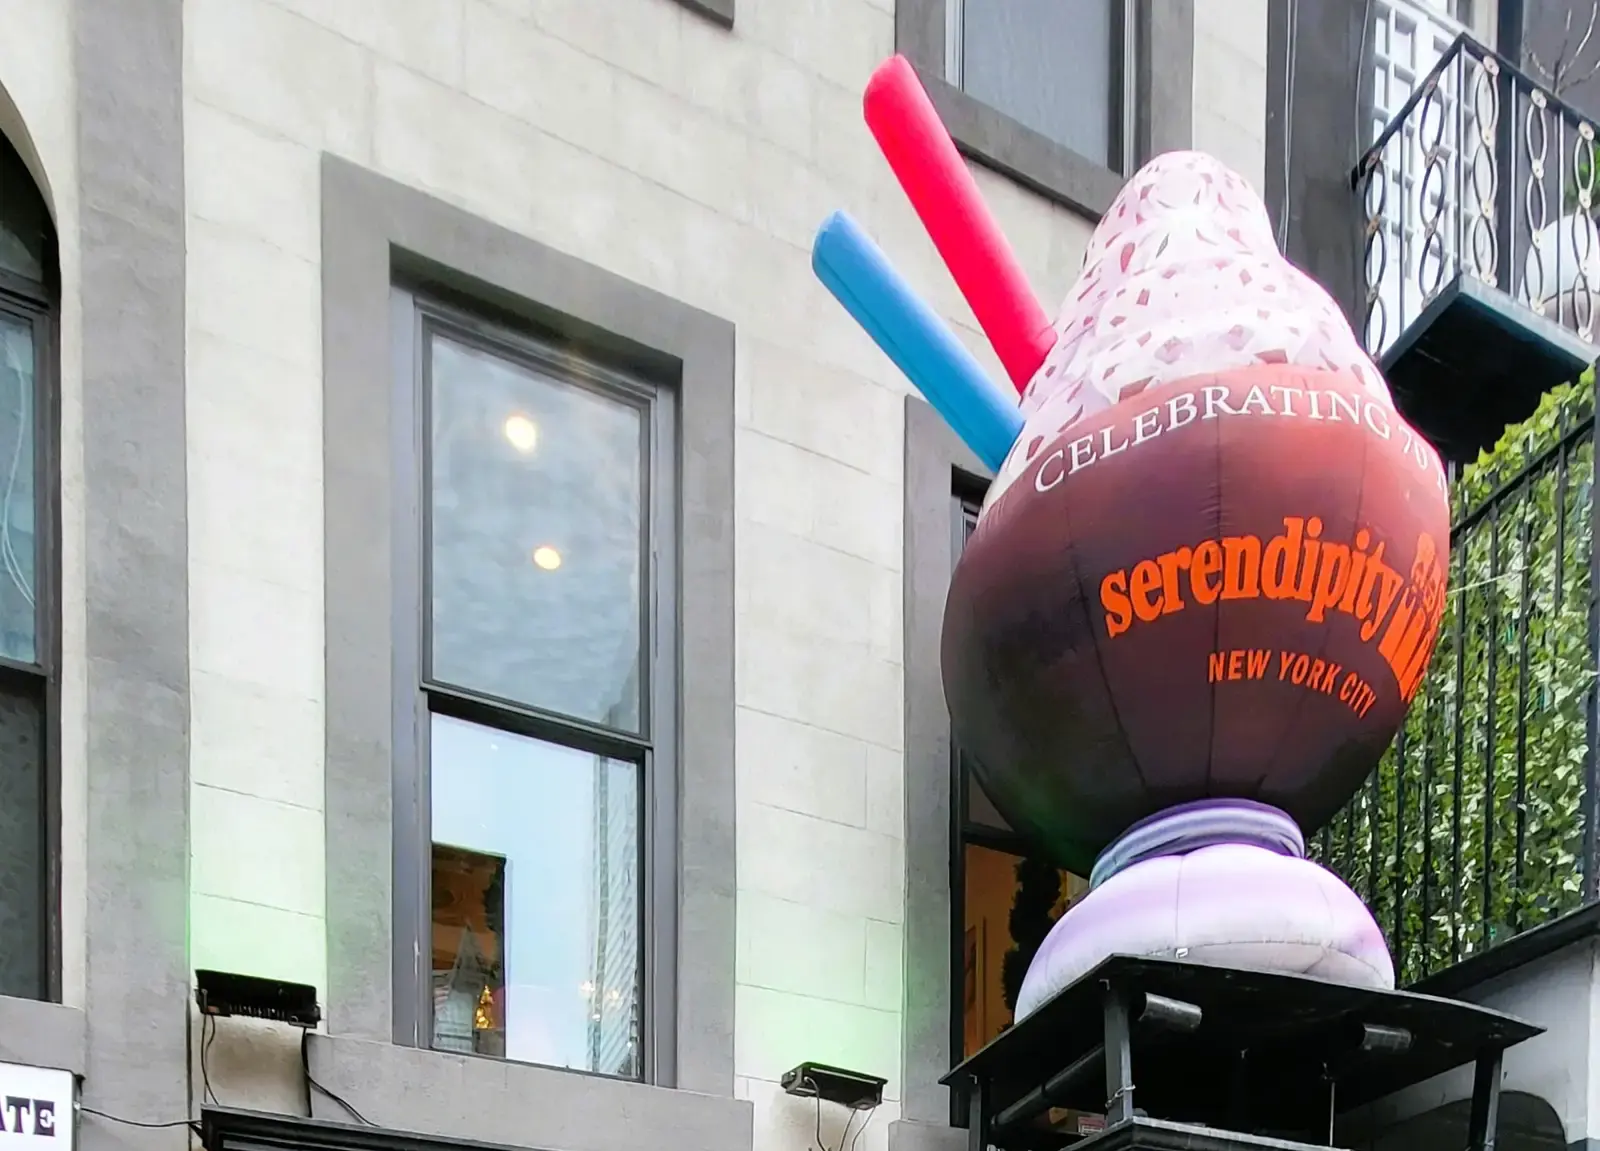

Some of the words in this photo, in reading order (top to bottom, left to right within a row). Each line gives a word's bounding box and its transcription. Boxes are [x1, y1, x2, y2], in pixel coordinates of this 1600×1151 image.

[1034, 384, 1391, 492] CELEBRATING
[1398, 424, 1428, 470] 70
[1100, 516, 1404, 639] serendipity
[1208, 649, 1271, 683] NEW
[1278, 651, 1341, 695] YORK
[1339, 672, 1377, 719] CITY
